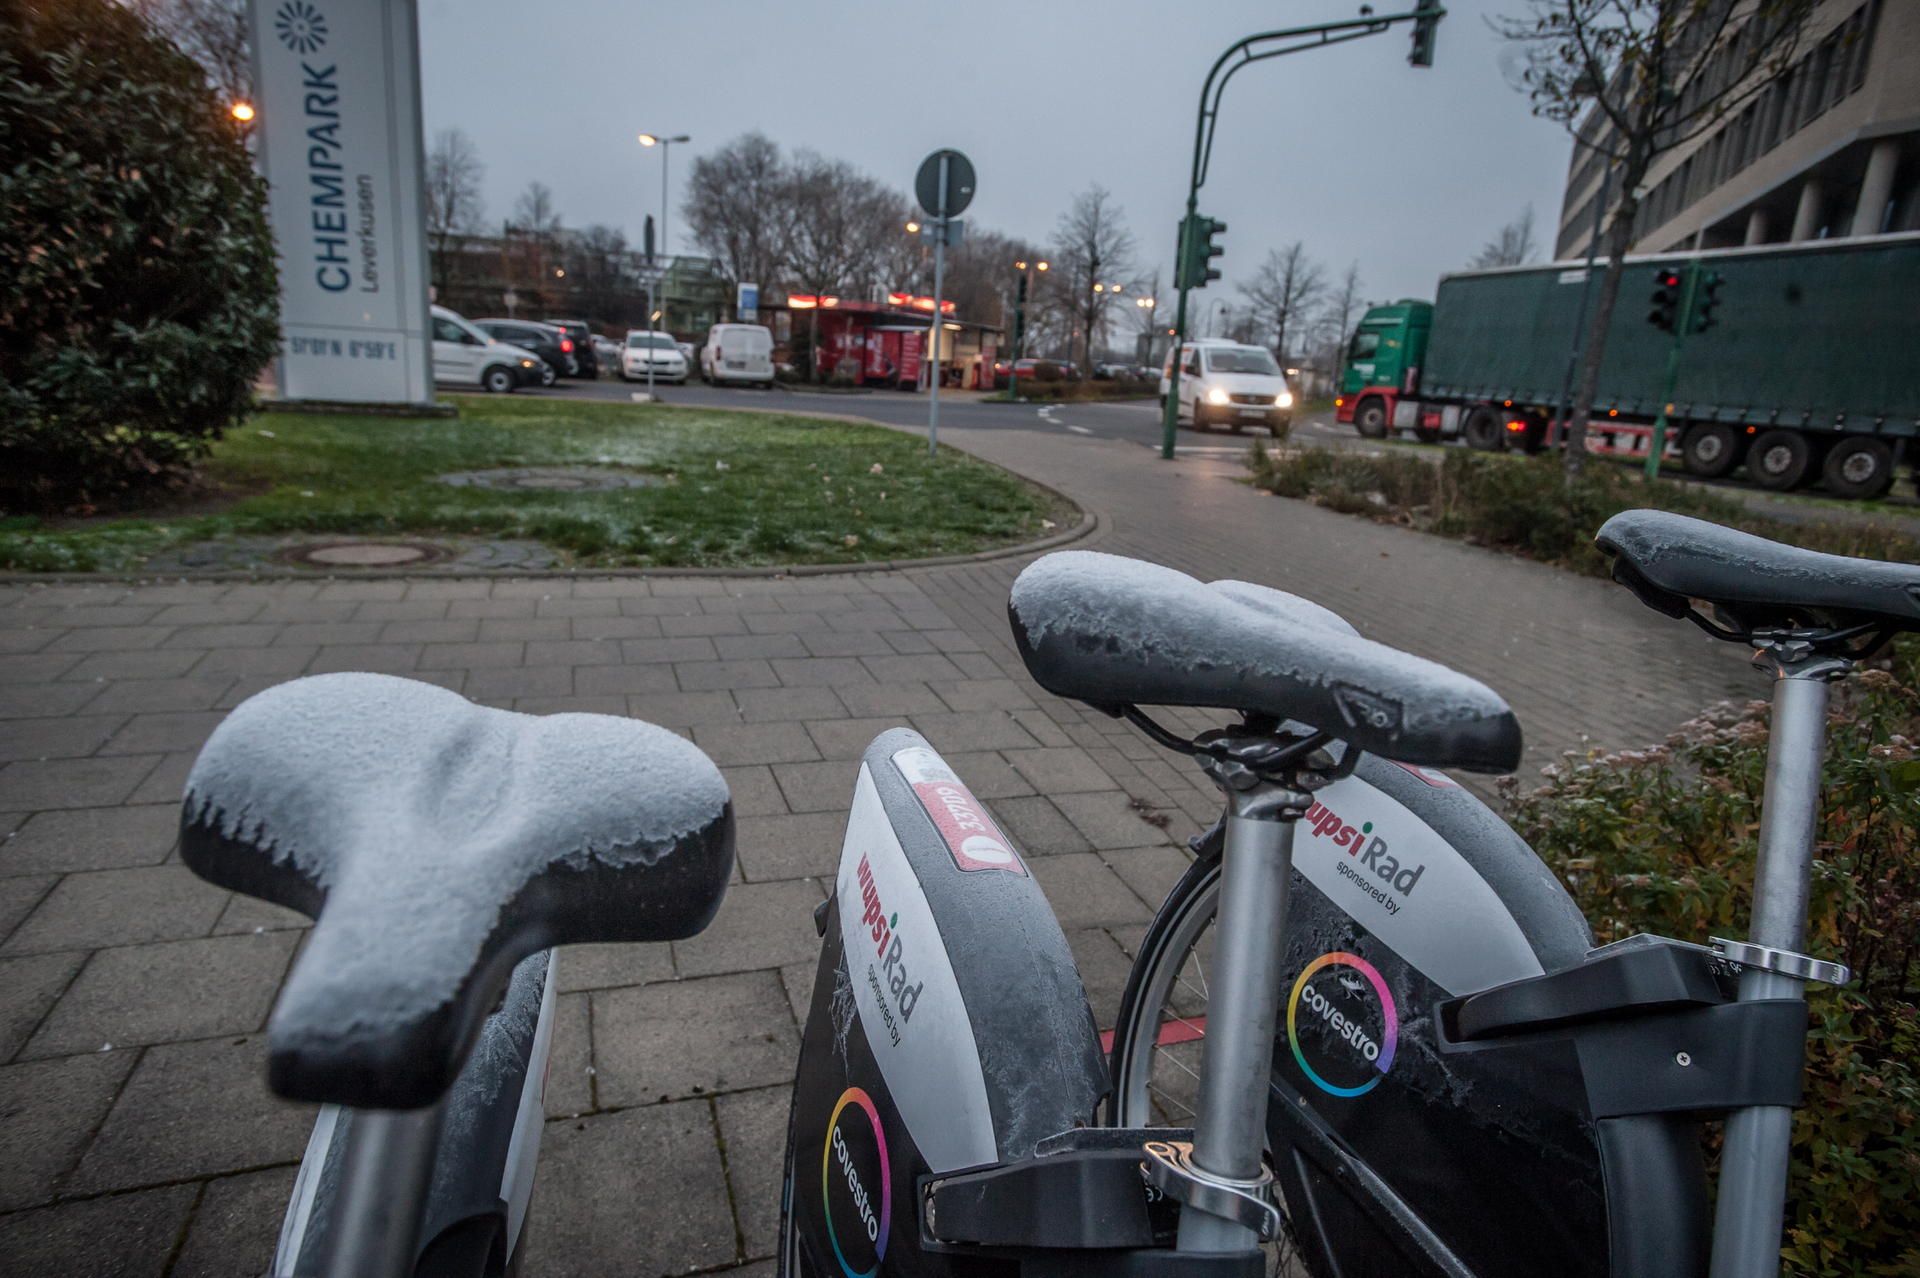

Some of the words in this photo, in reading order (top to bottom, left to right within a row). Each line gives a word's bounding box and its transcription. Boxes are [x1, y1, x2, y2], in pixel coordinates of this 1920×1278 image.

[302, 62, 350, 292] CHEMPARK
[356, 174, 378, 293] Leverkusen
[936, 787, 985, 831] 33709
[1305, 801, 1425, 896] upsiRad
[1336, 859, 1387, 904] sponsored
[1384, 893, 1401, 915] by
[867, 963, 892, 1028] sponsored
[890, 1018, 901, 1047] by
[1301, 984, 1380, 1062] covestro
[833, 1126, 878, 1242] covestro
